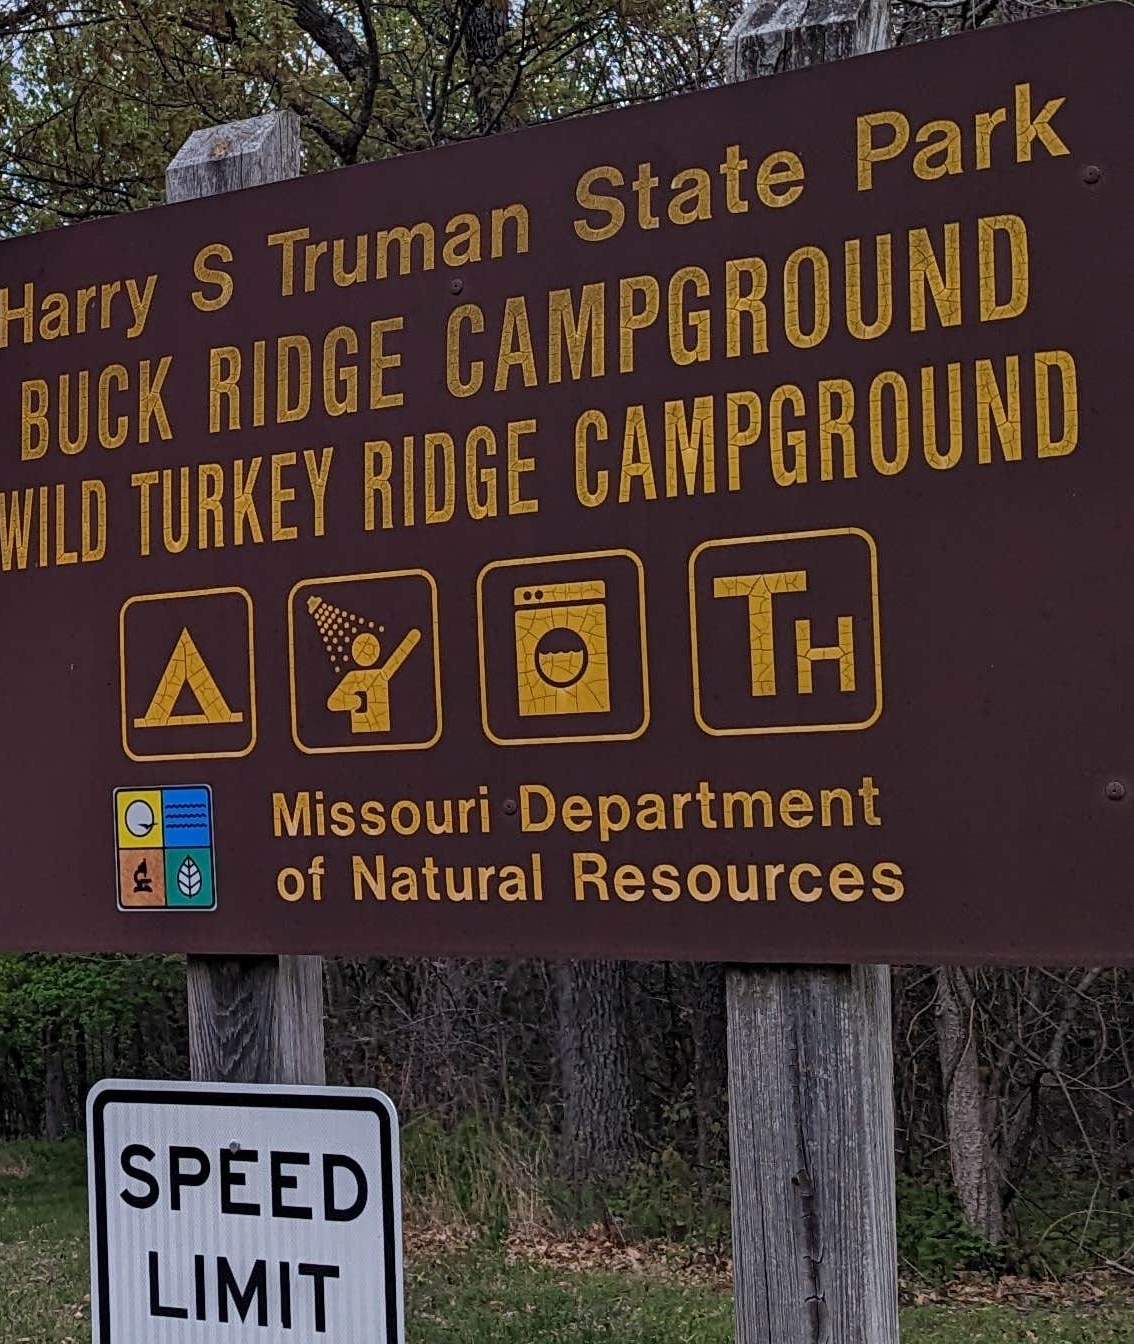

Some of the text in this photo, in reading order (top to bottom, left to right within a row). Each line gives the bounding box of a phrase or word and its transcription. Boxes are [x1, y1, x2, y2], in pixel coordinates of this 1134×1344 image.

[0, 83, 1071, 349] Harry S Truman State Park
[21, 214, 1029, 462] BUCK RIDGE CAMPGROUND
[131, 446, 334, 556] TURKEY
[364, 418, 539, 531] RIDGE
[575, 350, 1079, 508] CAMPGROUND
[272, 776, 882, 842] Missouri Department
[276, 852, 905, 903] of Natural Resources
[120, 1143, 368, 1222] SPEED
[148, 1251, 340, 1333] LIMIT
